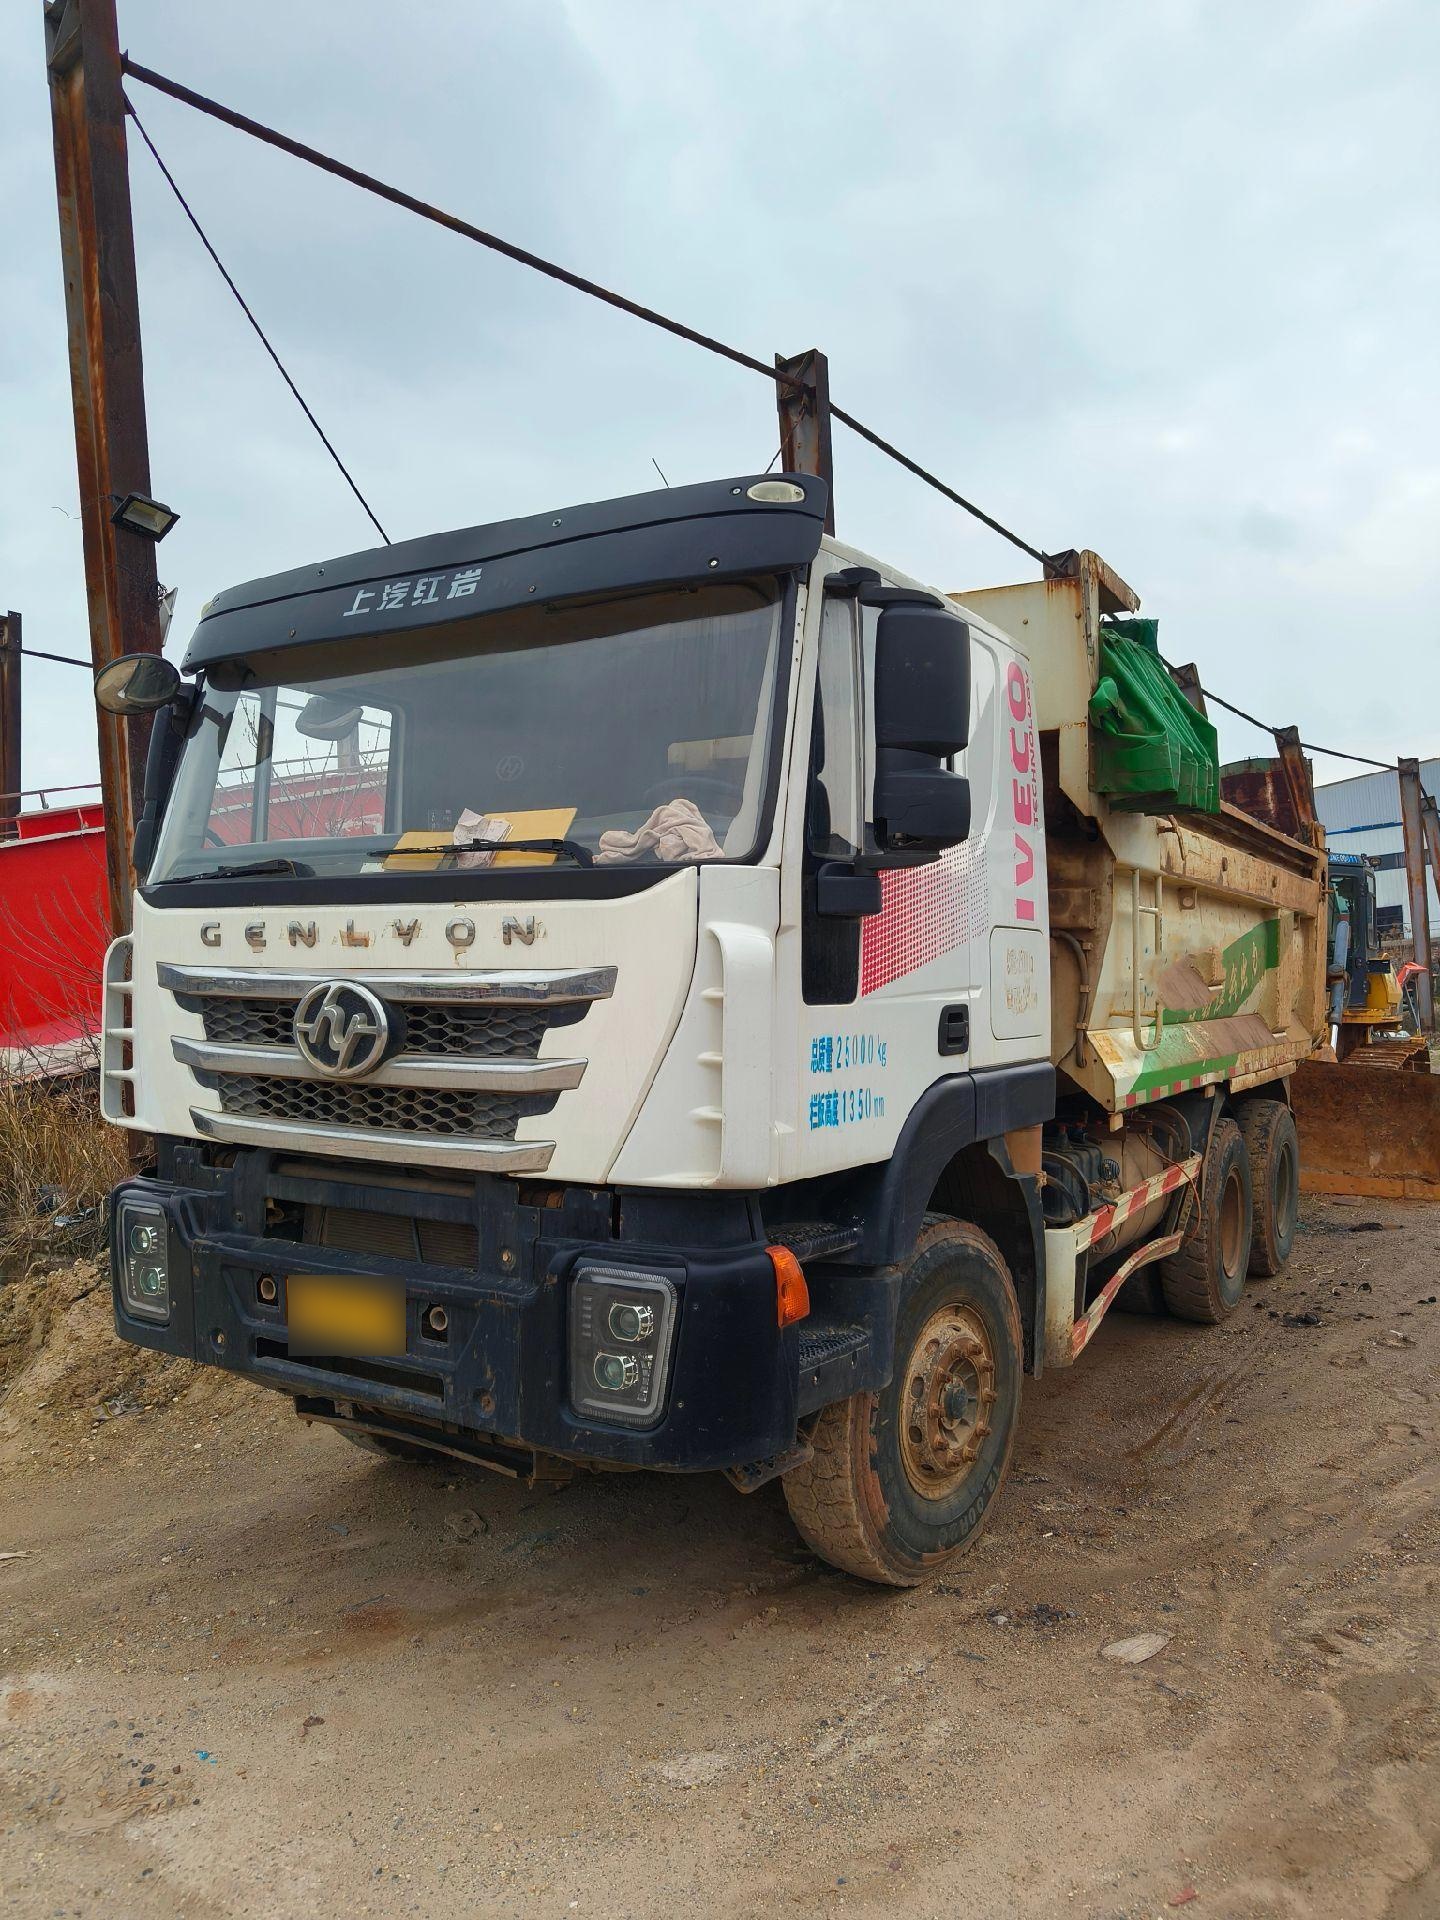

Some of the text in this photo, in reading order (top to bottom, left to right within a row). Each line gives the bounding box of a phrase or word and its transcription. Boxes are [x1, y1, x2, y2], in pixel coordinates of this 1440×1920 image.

[343, 568, 482, 617] 上汽红岩
[1007, 661, 1035, 921] IVECO
[1025, 669, 1039, 830] TECHNOLOGY
[200, 915, 536, 948] GENLYON
